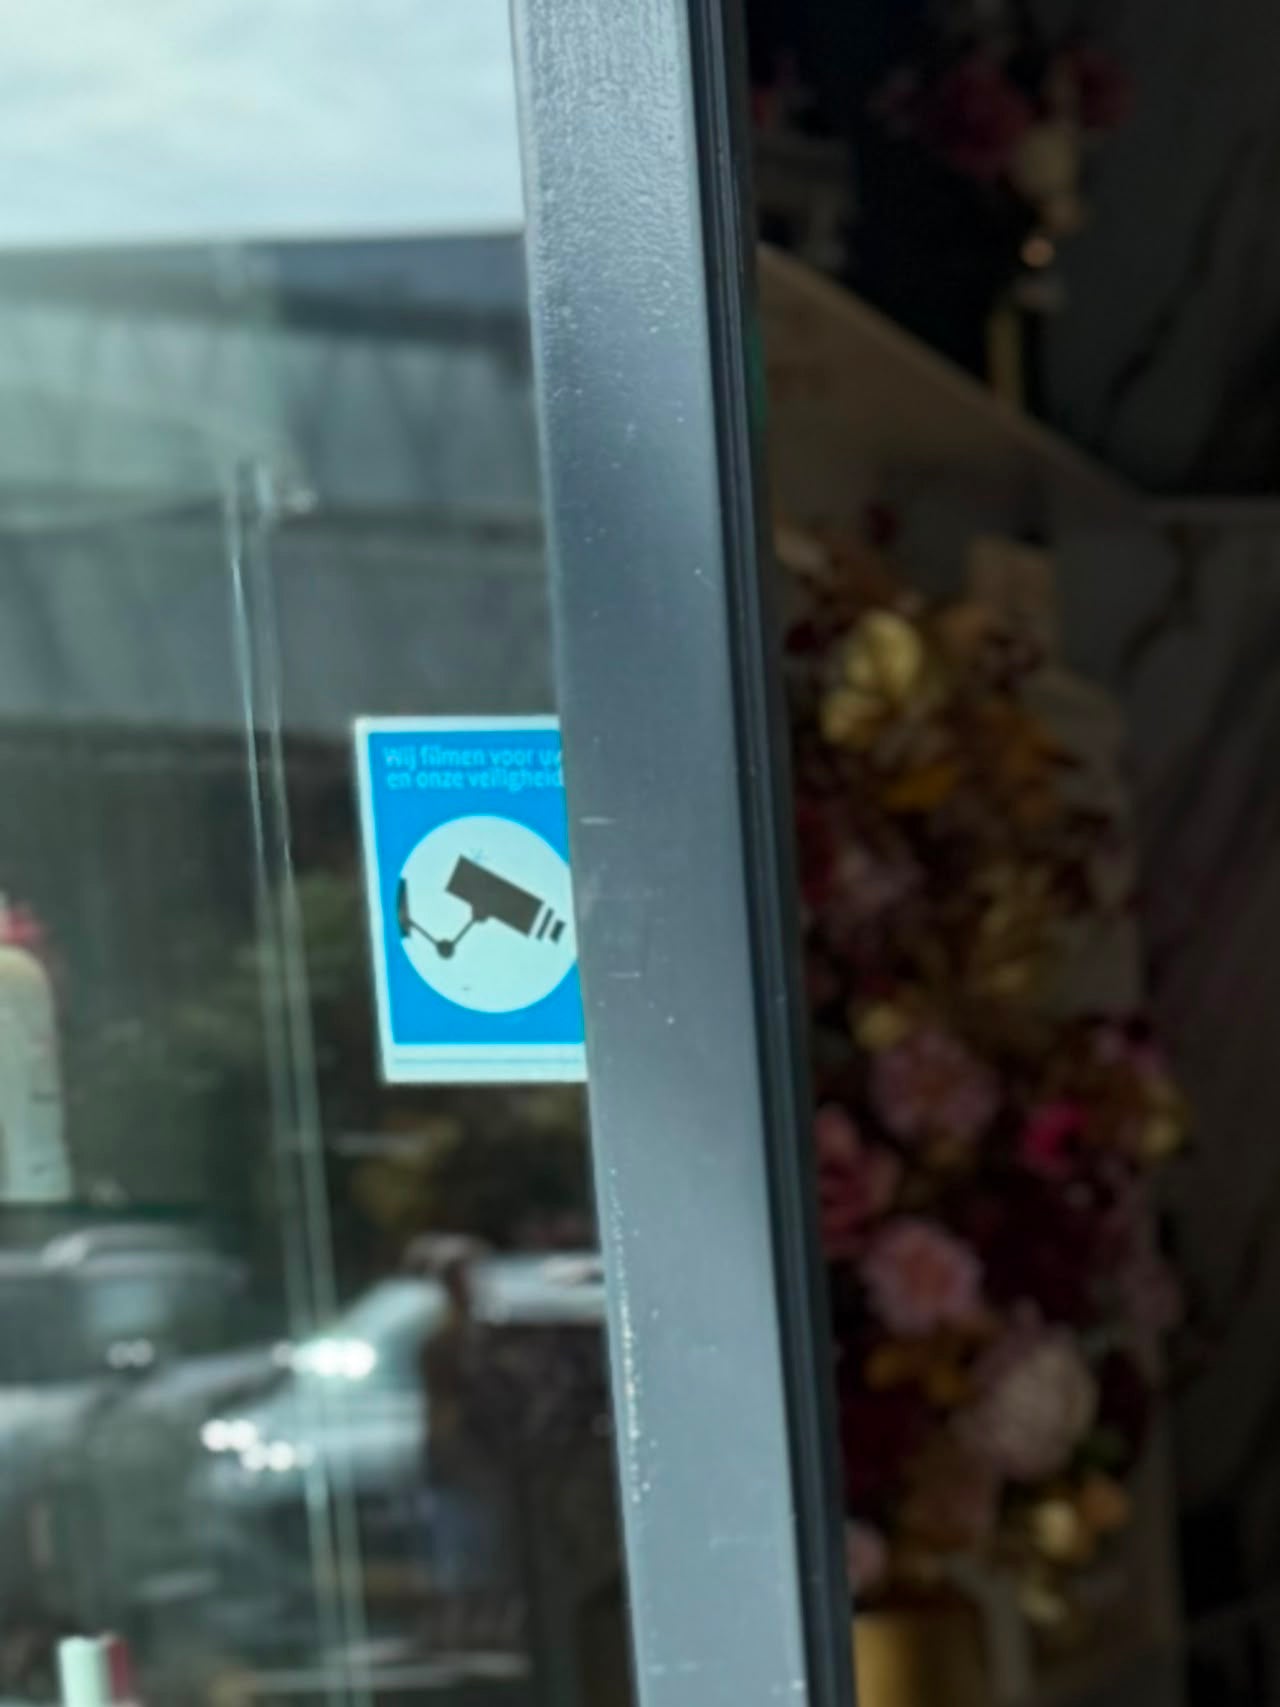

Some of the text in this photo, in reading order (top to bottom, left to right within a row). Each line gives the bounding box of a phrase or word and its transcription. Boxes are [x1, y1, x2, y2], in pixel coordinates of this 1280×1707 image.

[384, 745, 417, 770] Wij
[419, 744, 486, 767] filmen
[489, 748, 532, 767] voor
[386, 770, 412, 790] en
[416, 769, 464, 789] onze
